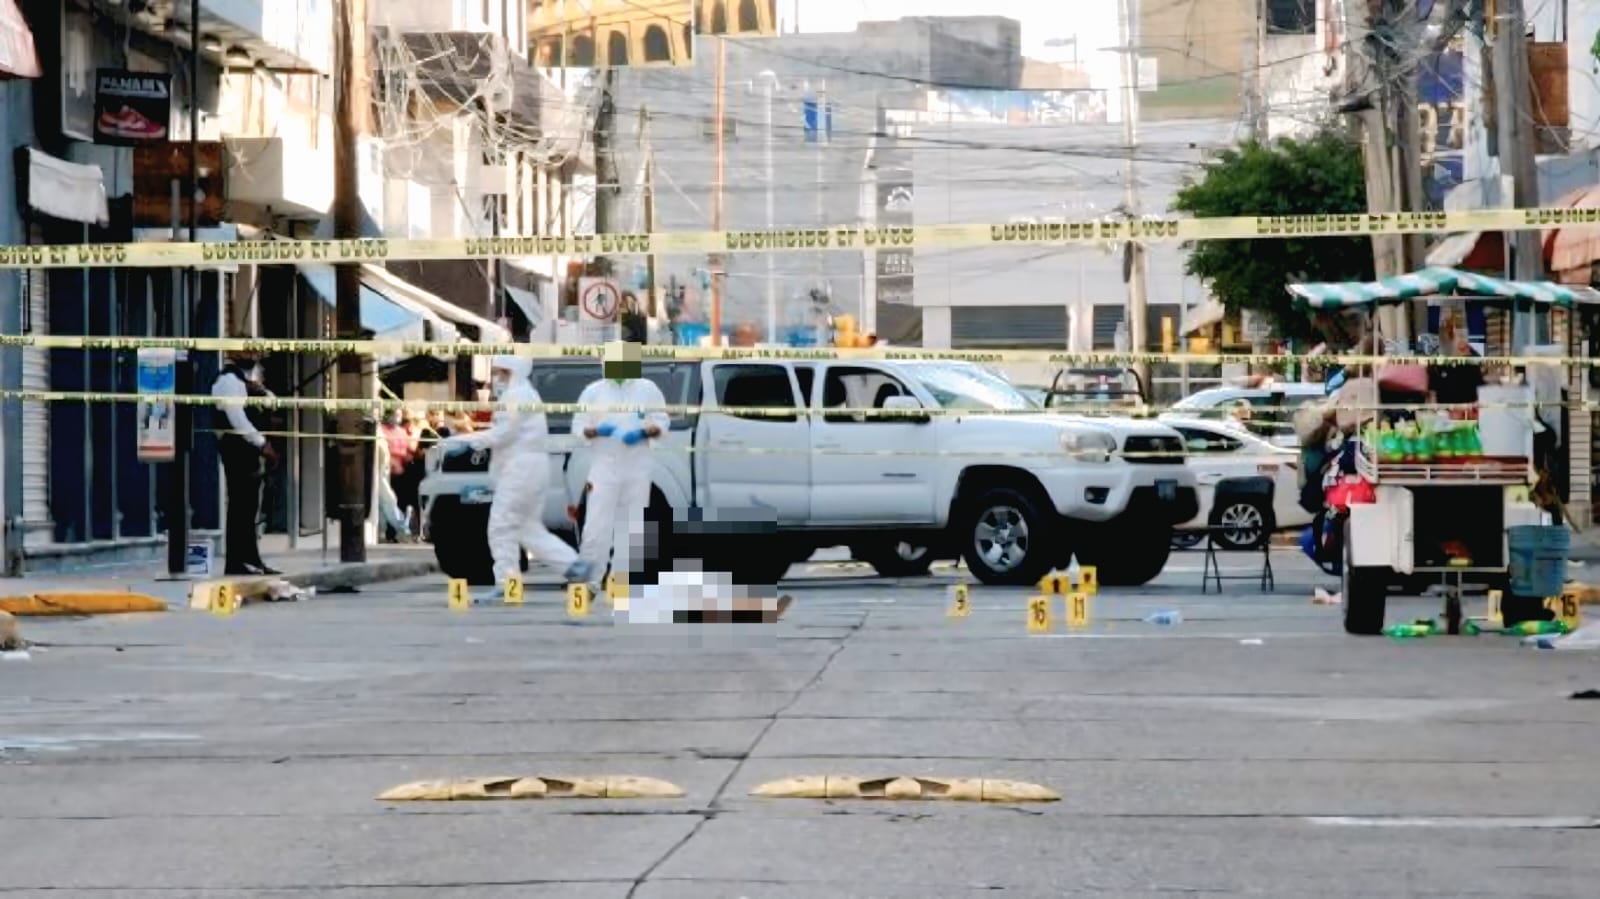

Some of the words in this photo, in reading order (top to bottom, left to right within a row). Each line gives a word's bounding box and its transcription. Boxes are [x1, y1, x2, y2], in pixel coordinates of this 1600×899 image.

[218, 585, 227, 608] 6
[453, 583, 461, 604] 4
[508, 578, 517, 598] 2
[573, 587, 582, 608] 5
[1561, 594, 1575, 617] 15
